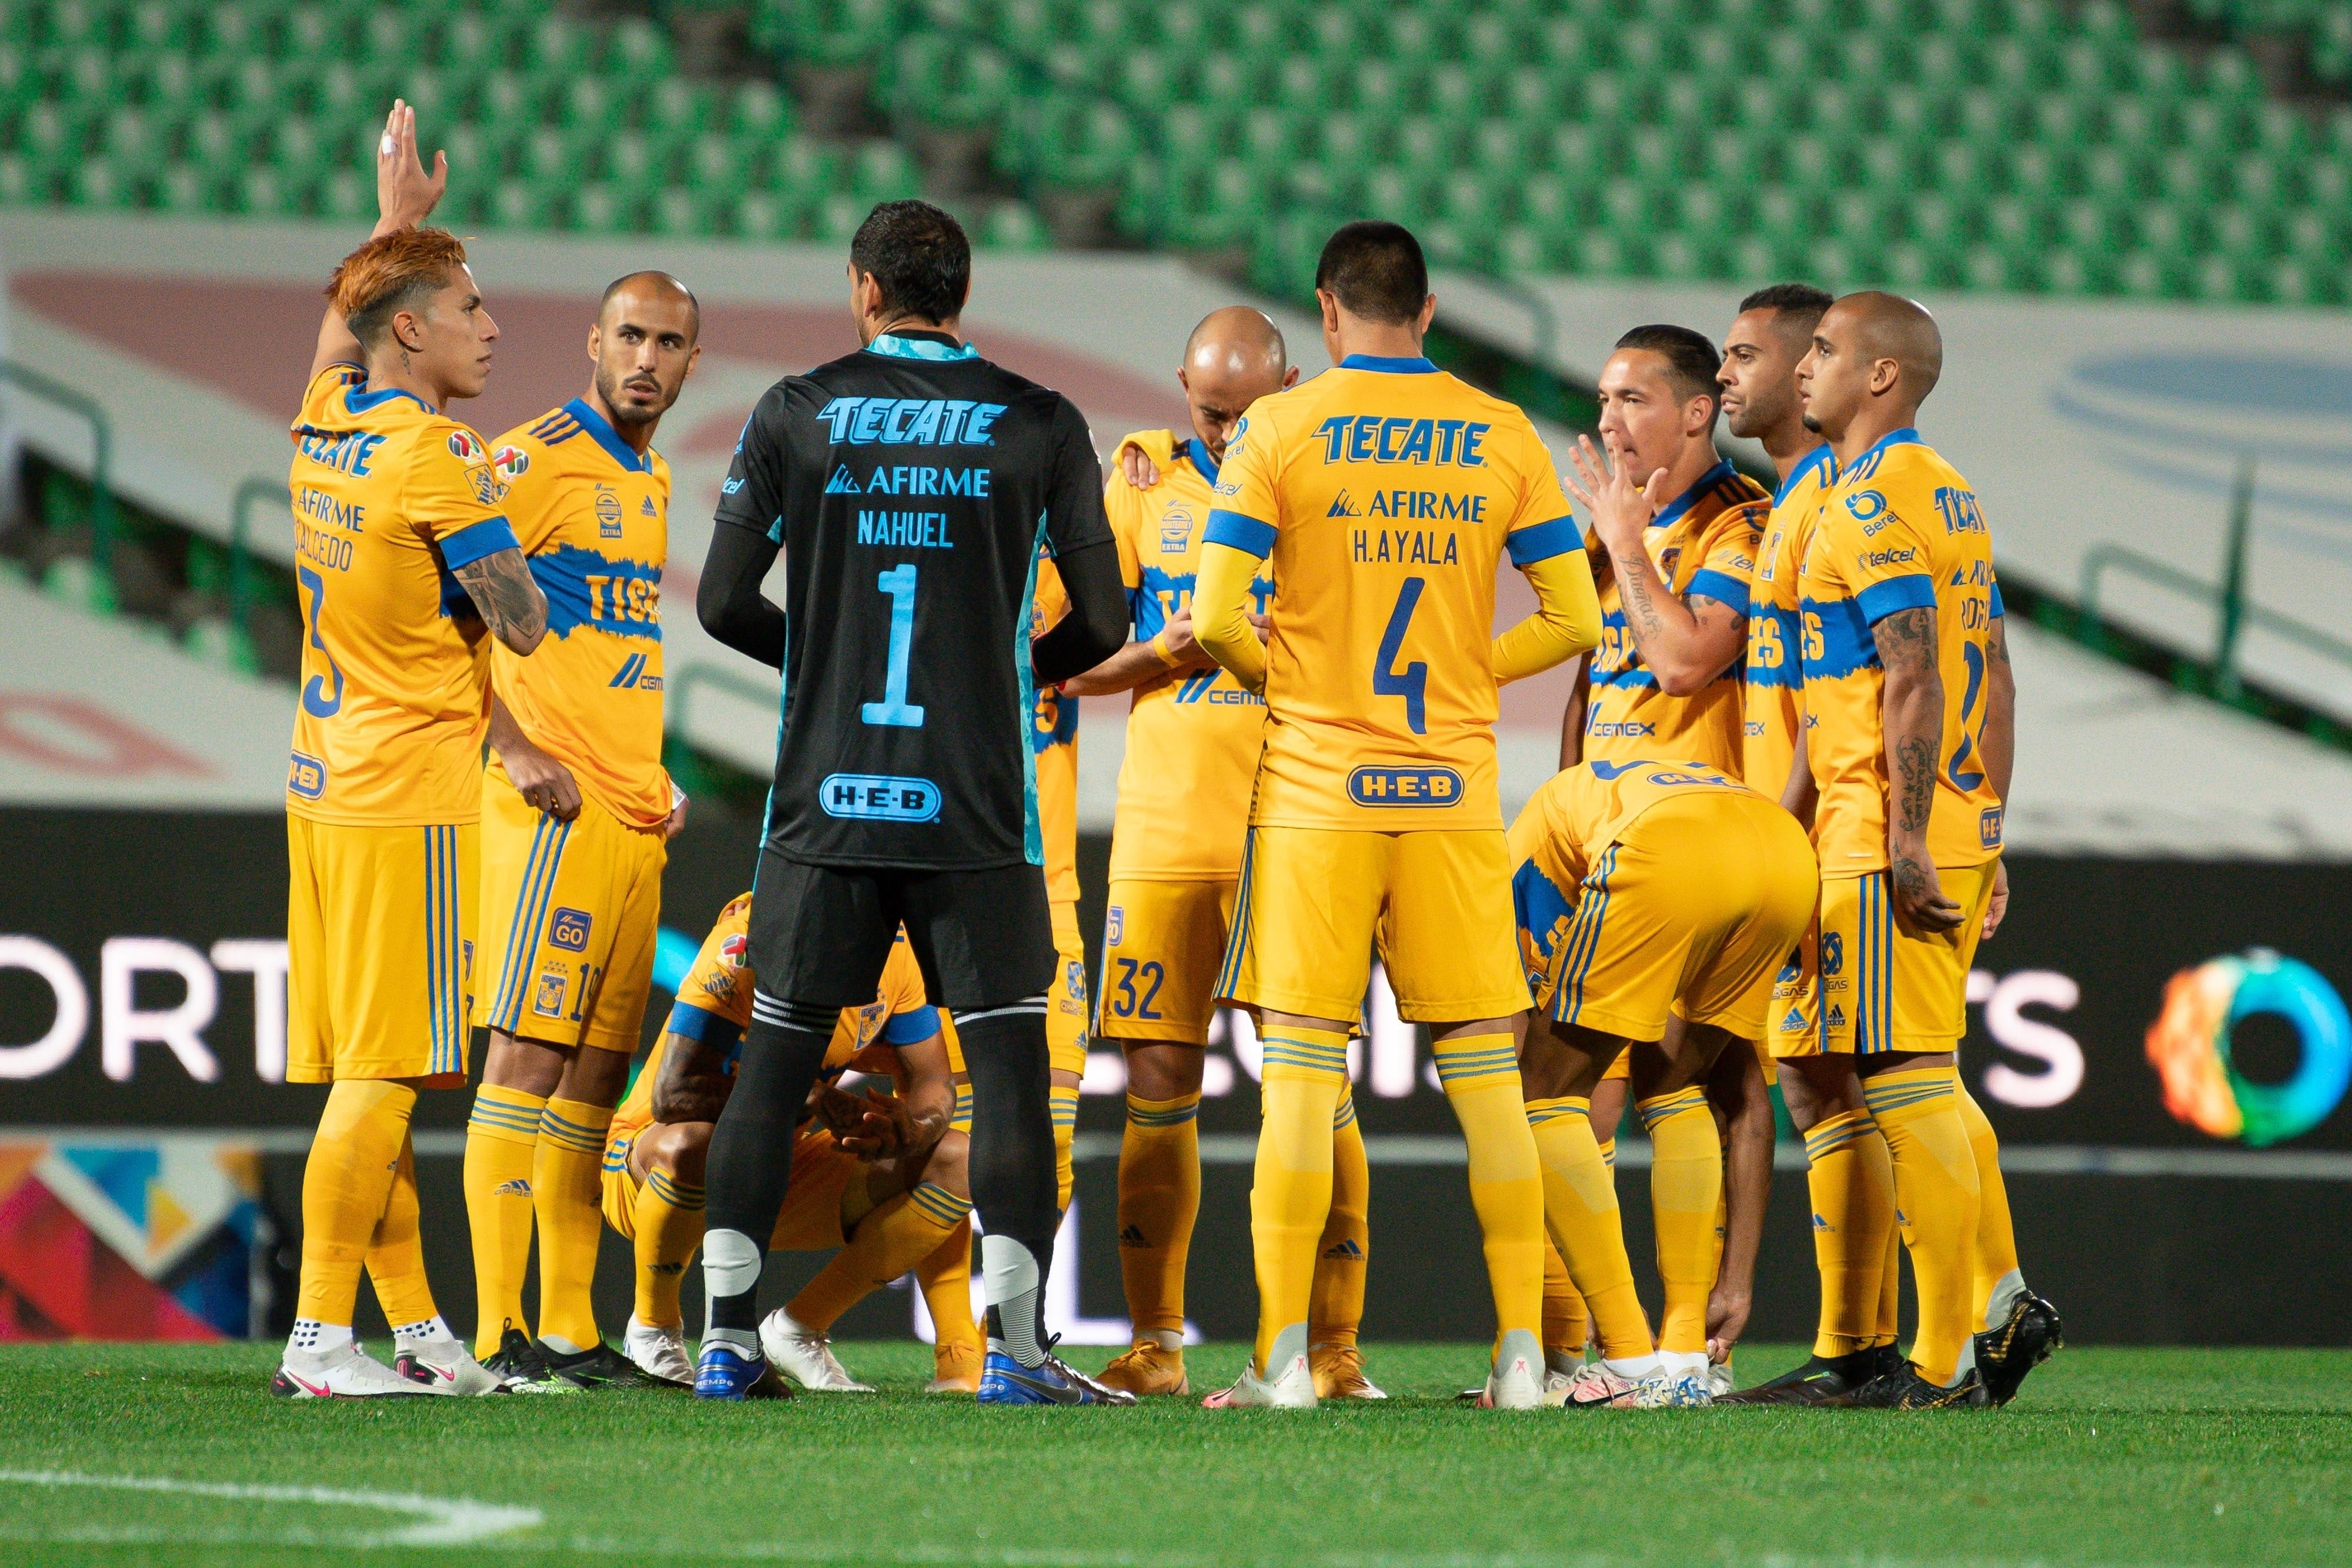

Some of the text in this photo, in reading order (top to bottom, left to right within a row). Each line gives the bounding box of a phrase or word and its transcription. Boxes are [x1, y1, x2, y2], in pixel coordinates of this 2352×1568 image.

[816, 397, 1008, 445] TECATE
[294, 423, 389, 479] ECATE
[1311, 415, 1491, 468] TECATE
[867, 466, 990, 497] AFIRME
[297, 486, 365, 533] AFIRME
[1368, 490, 1488, 523] AFIRME
[601, 529, 621, 537] EXTRA
[858, 510, 954, 548] NAHUEL
[1162, 543, 1185, 551] EXTRA
[1354, 529, 1458, 566] H.AYALA
[1869, 546, 1916, 567] telcel
[299, 564, 345, 718] 3
[862, 564, 924, 727] 1
[1373, 577, 1428, 734] 4
[1594, 722, 1656, 737] CEMEX
[833, 785, 926, 810] H-E-B
[1362, 775, 1452, 797] H-E-B
[556, 925, 583, 945] GO
[1114, 958, 1164, 1020] 32
[1781, 987, 1809, 997] GAS
[1829, 980, 1847, 990] GAS
